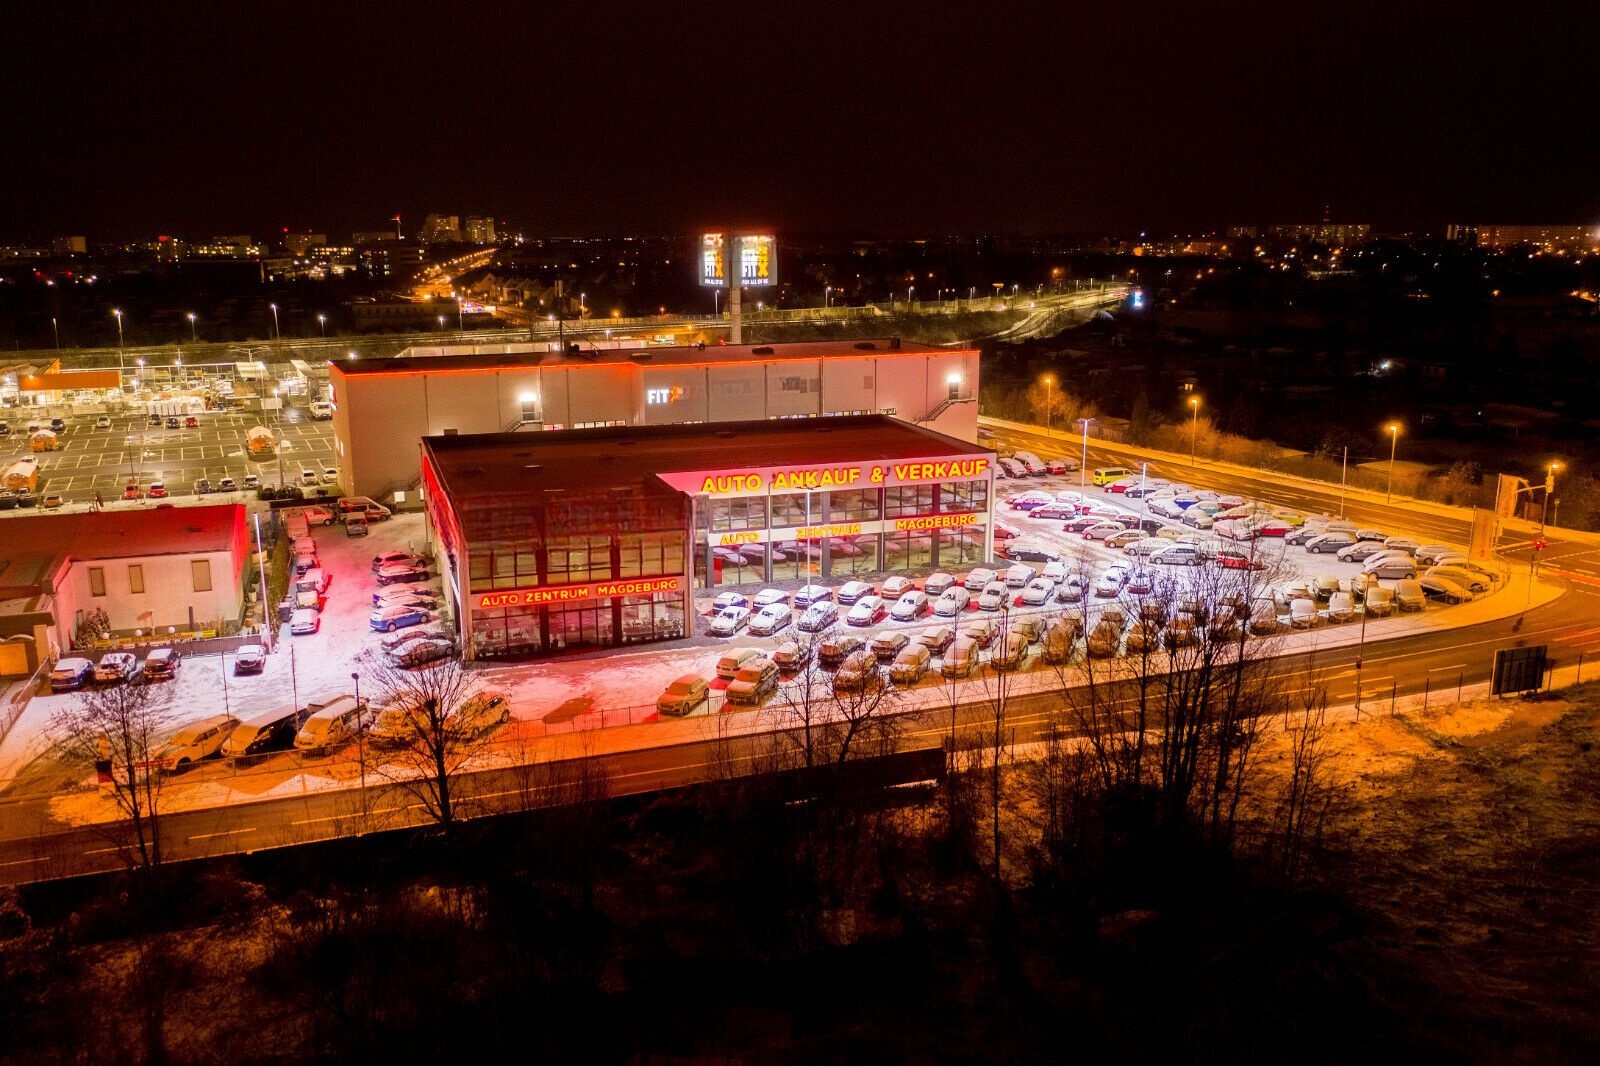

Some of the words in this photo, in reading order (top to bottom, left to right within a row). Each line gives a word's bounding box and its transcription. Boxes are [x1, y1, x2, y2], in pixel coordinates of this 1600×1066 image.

[701, 474, 763, 494] AUTO
[772, 468, 863, 490] ANKAUF
[870, 466, 885, 484] &
[894, 459, 988, 482] VERKAUF
[720, 531, 760, 545] AUTO
[796, 523, 861, 539] ZENTRUM
[895, 513, 977, 531] MAGDEBURG
[480, 595, 519, 608] AUTO
[525, 587, 588, 603] ZENTRUM
[597, 579, 679, 596] MAGDEBURG
